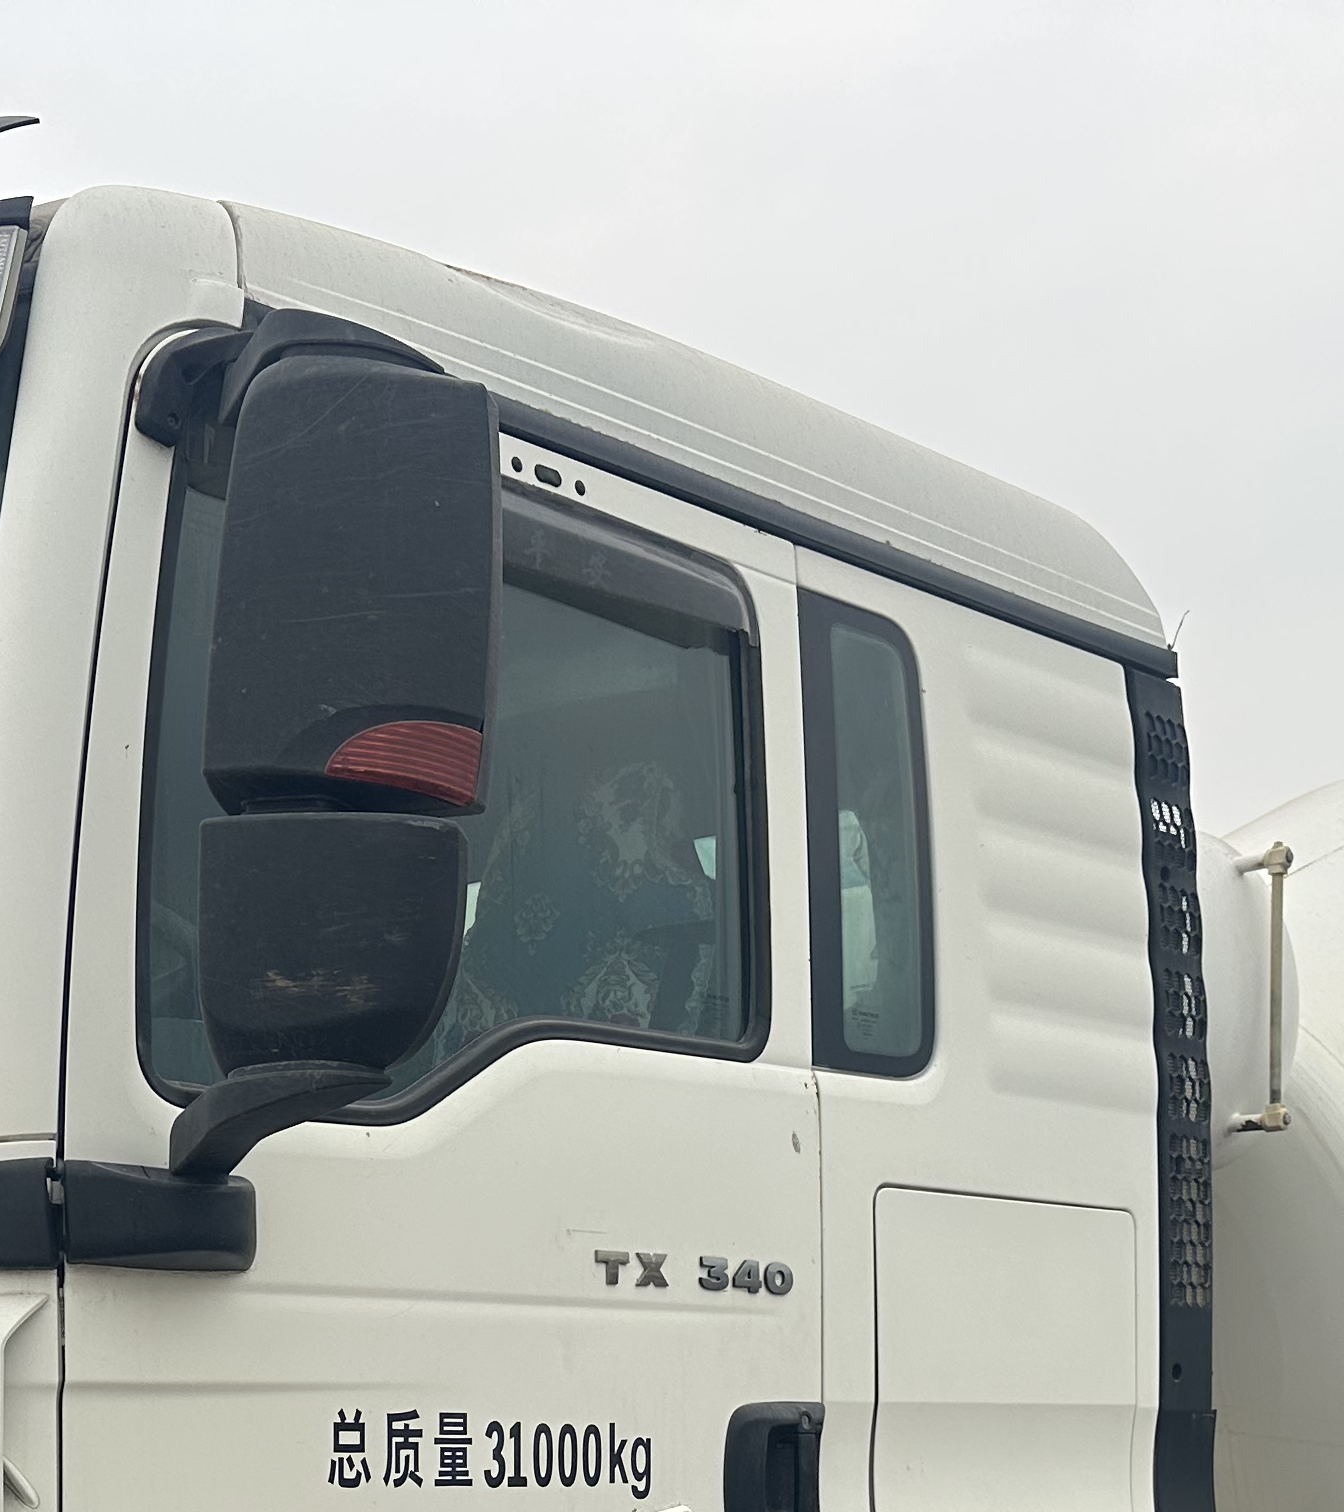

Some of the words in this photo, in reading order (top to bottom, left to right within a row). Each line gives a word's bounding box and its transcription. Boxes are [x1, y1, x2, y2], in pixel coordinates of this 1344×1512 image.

[595, 1249, 669, 1287] TX
[698, 1256, 793, 1295] 340
[328, 1408, 652, 1499] 总质量31000kg
